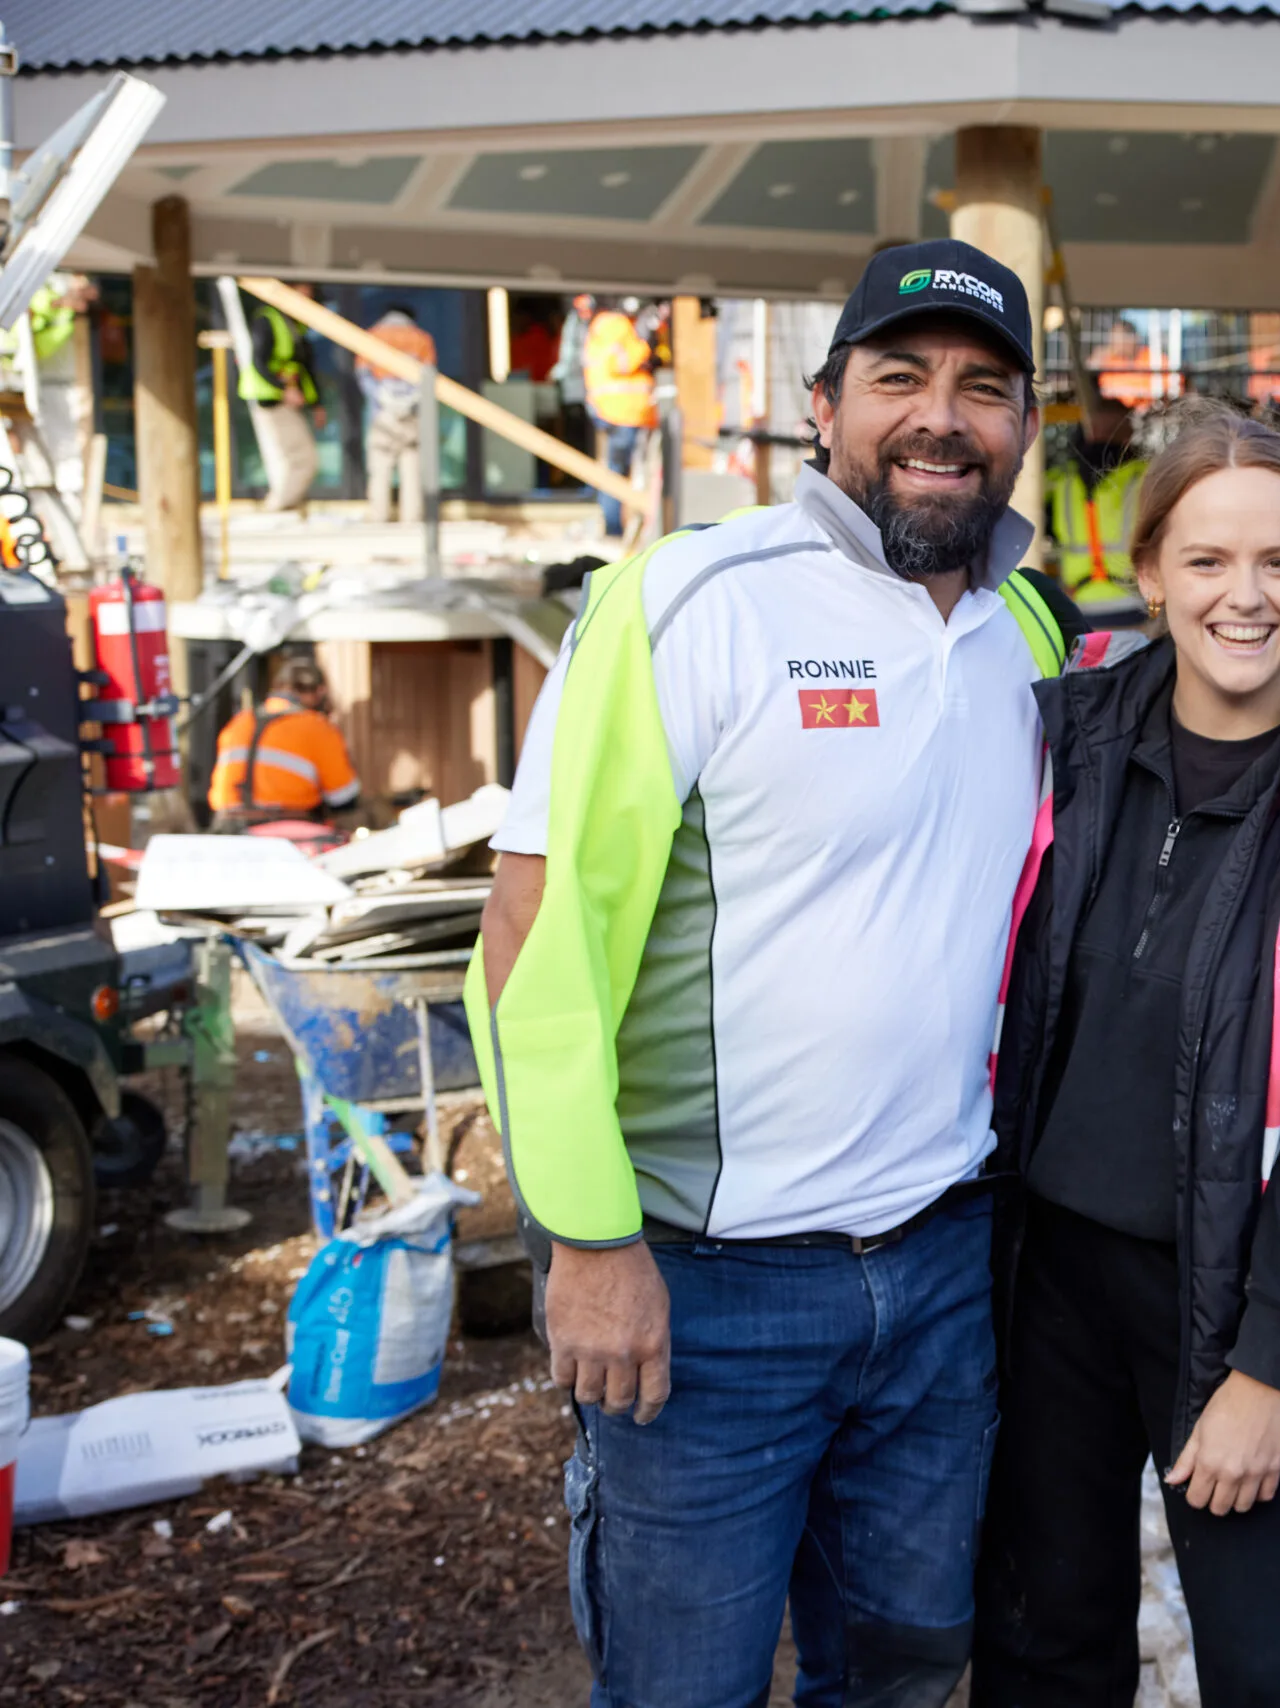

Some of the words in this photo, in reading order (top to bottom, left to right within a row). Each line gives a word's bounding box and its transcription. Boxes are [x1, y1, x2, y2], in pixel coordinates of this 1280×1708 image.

[932, 282, 1005, 314] LANDSCAPES
[934, 269, 1004, 306] RYCOR
[787, 659, 877, 679] RONNIE
